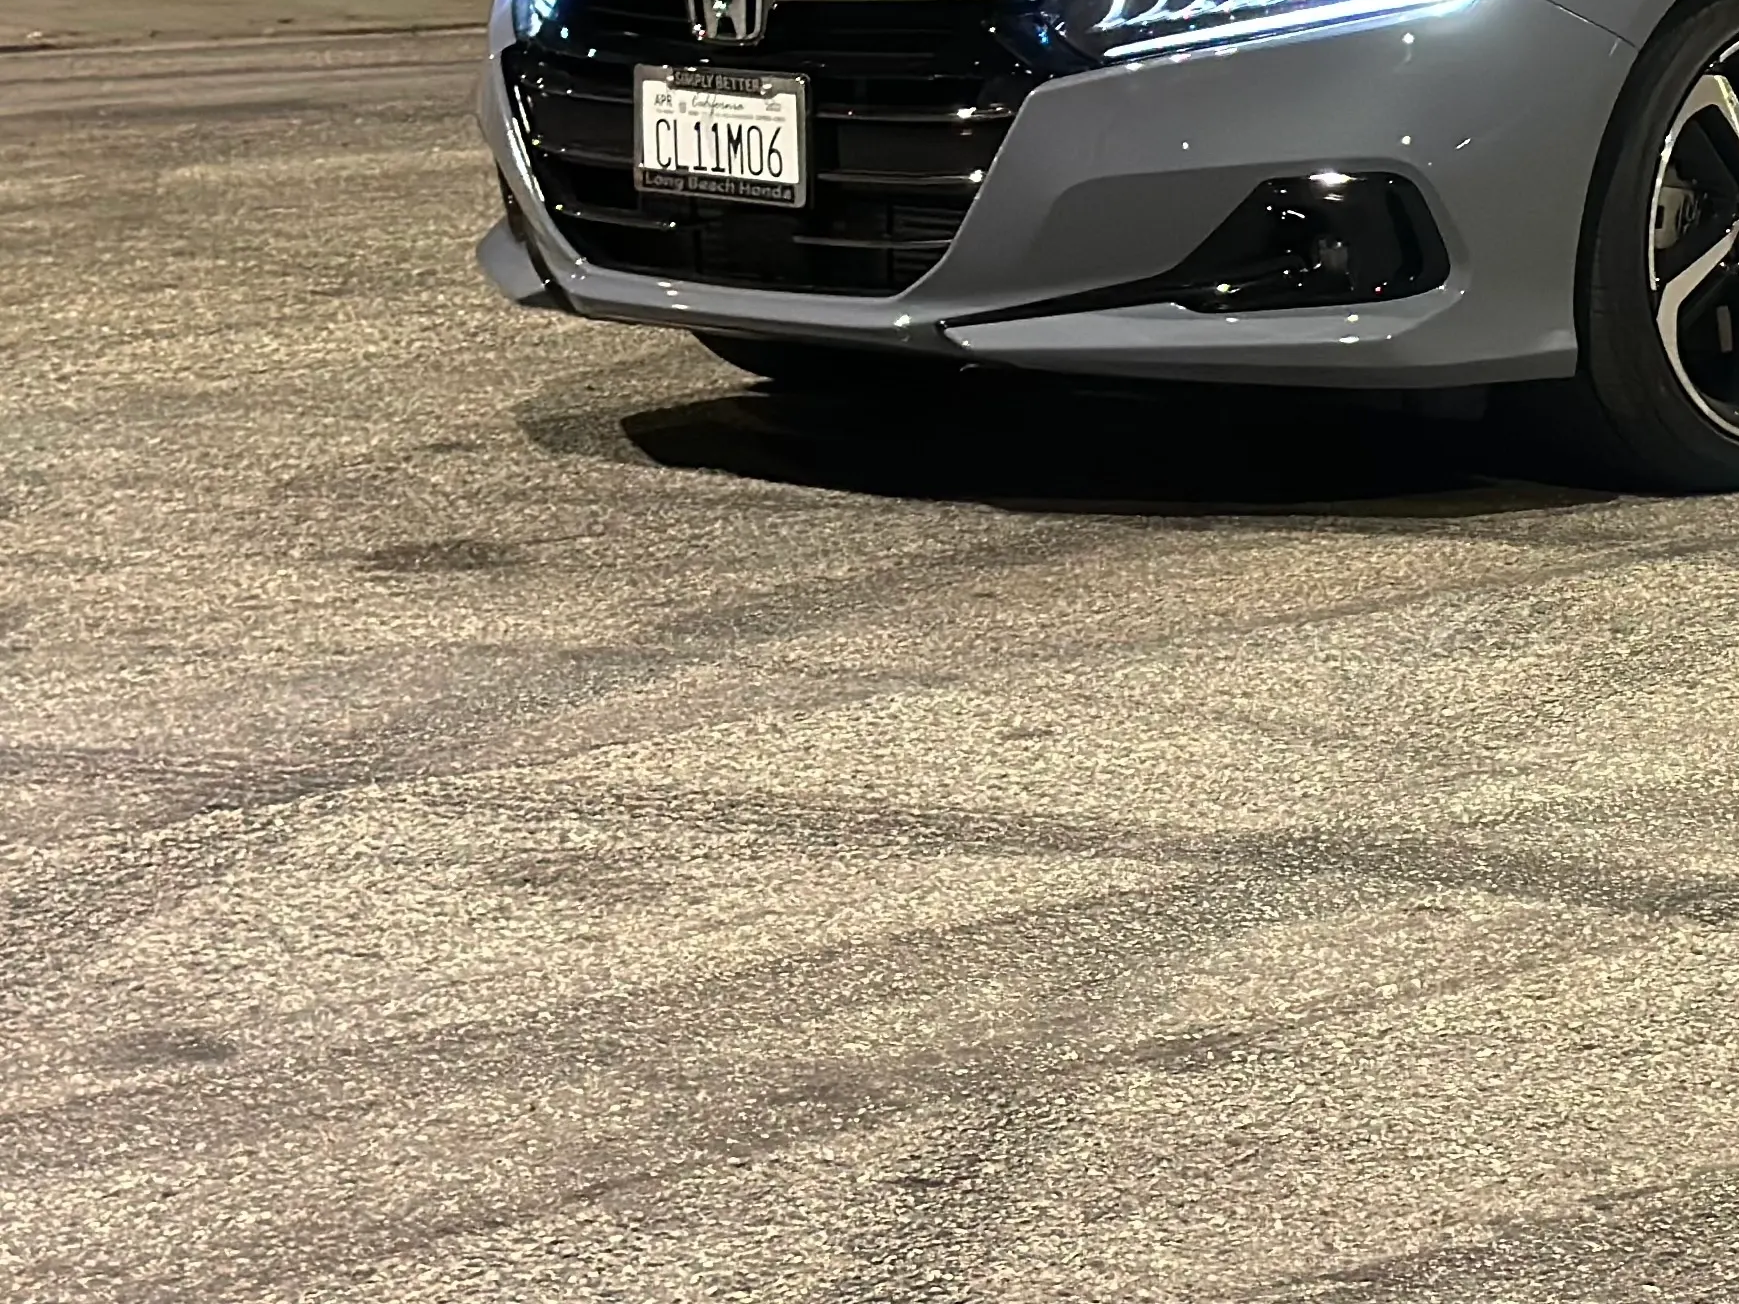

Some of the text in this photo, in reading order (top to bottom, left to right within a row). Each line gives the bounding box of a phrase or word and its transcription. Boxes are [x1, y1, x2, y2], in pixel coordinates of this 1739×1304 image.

[674, 71, 761, 93] SIMPLY BETTER
[645, 171, 792, 201] Long Beach Honda
